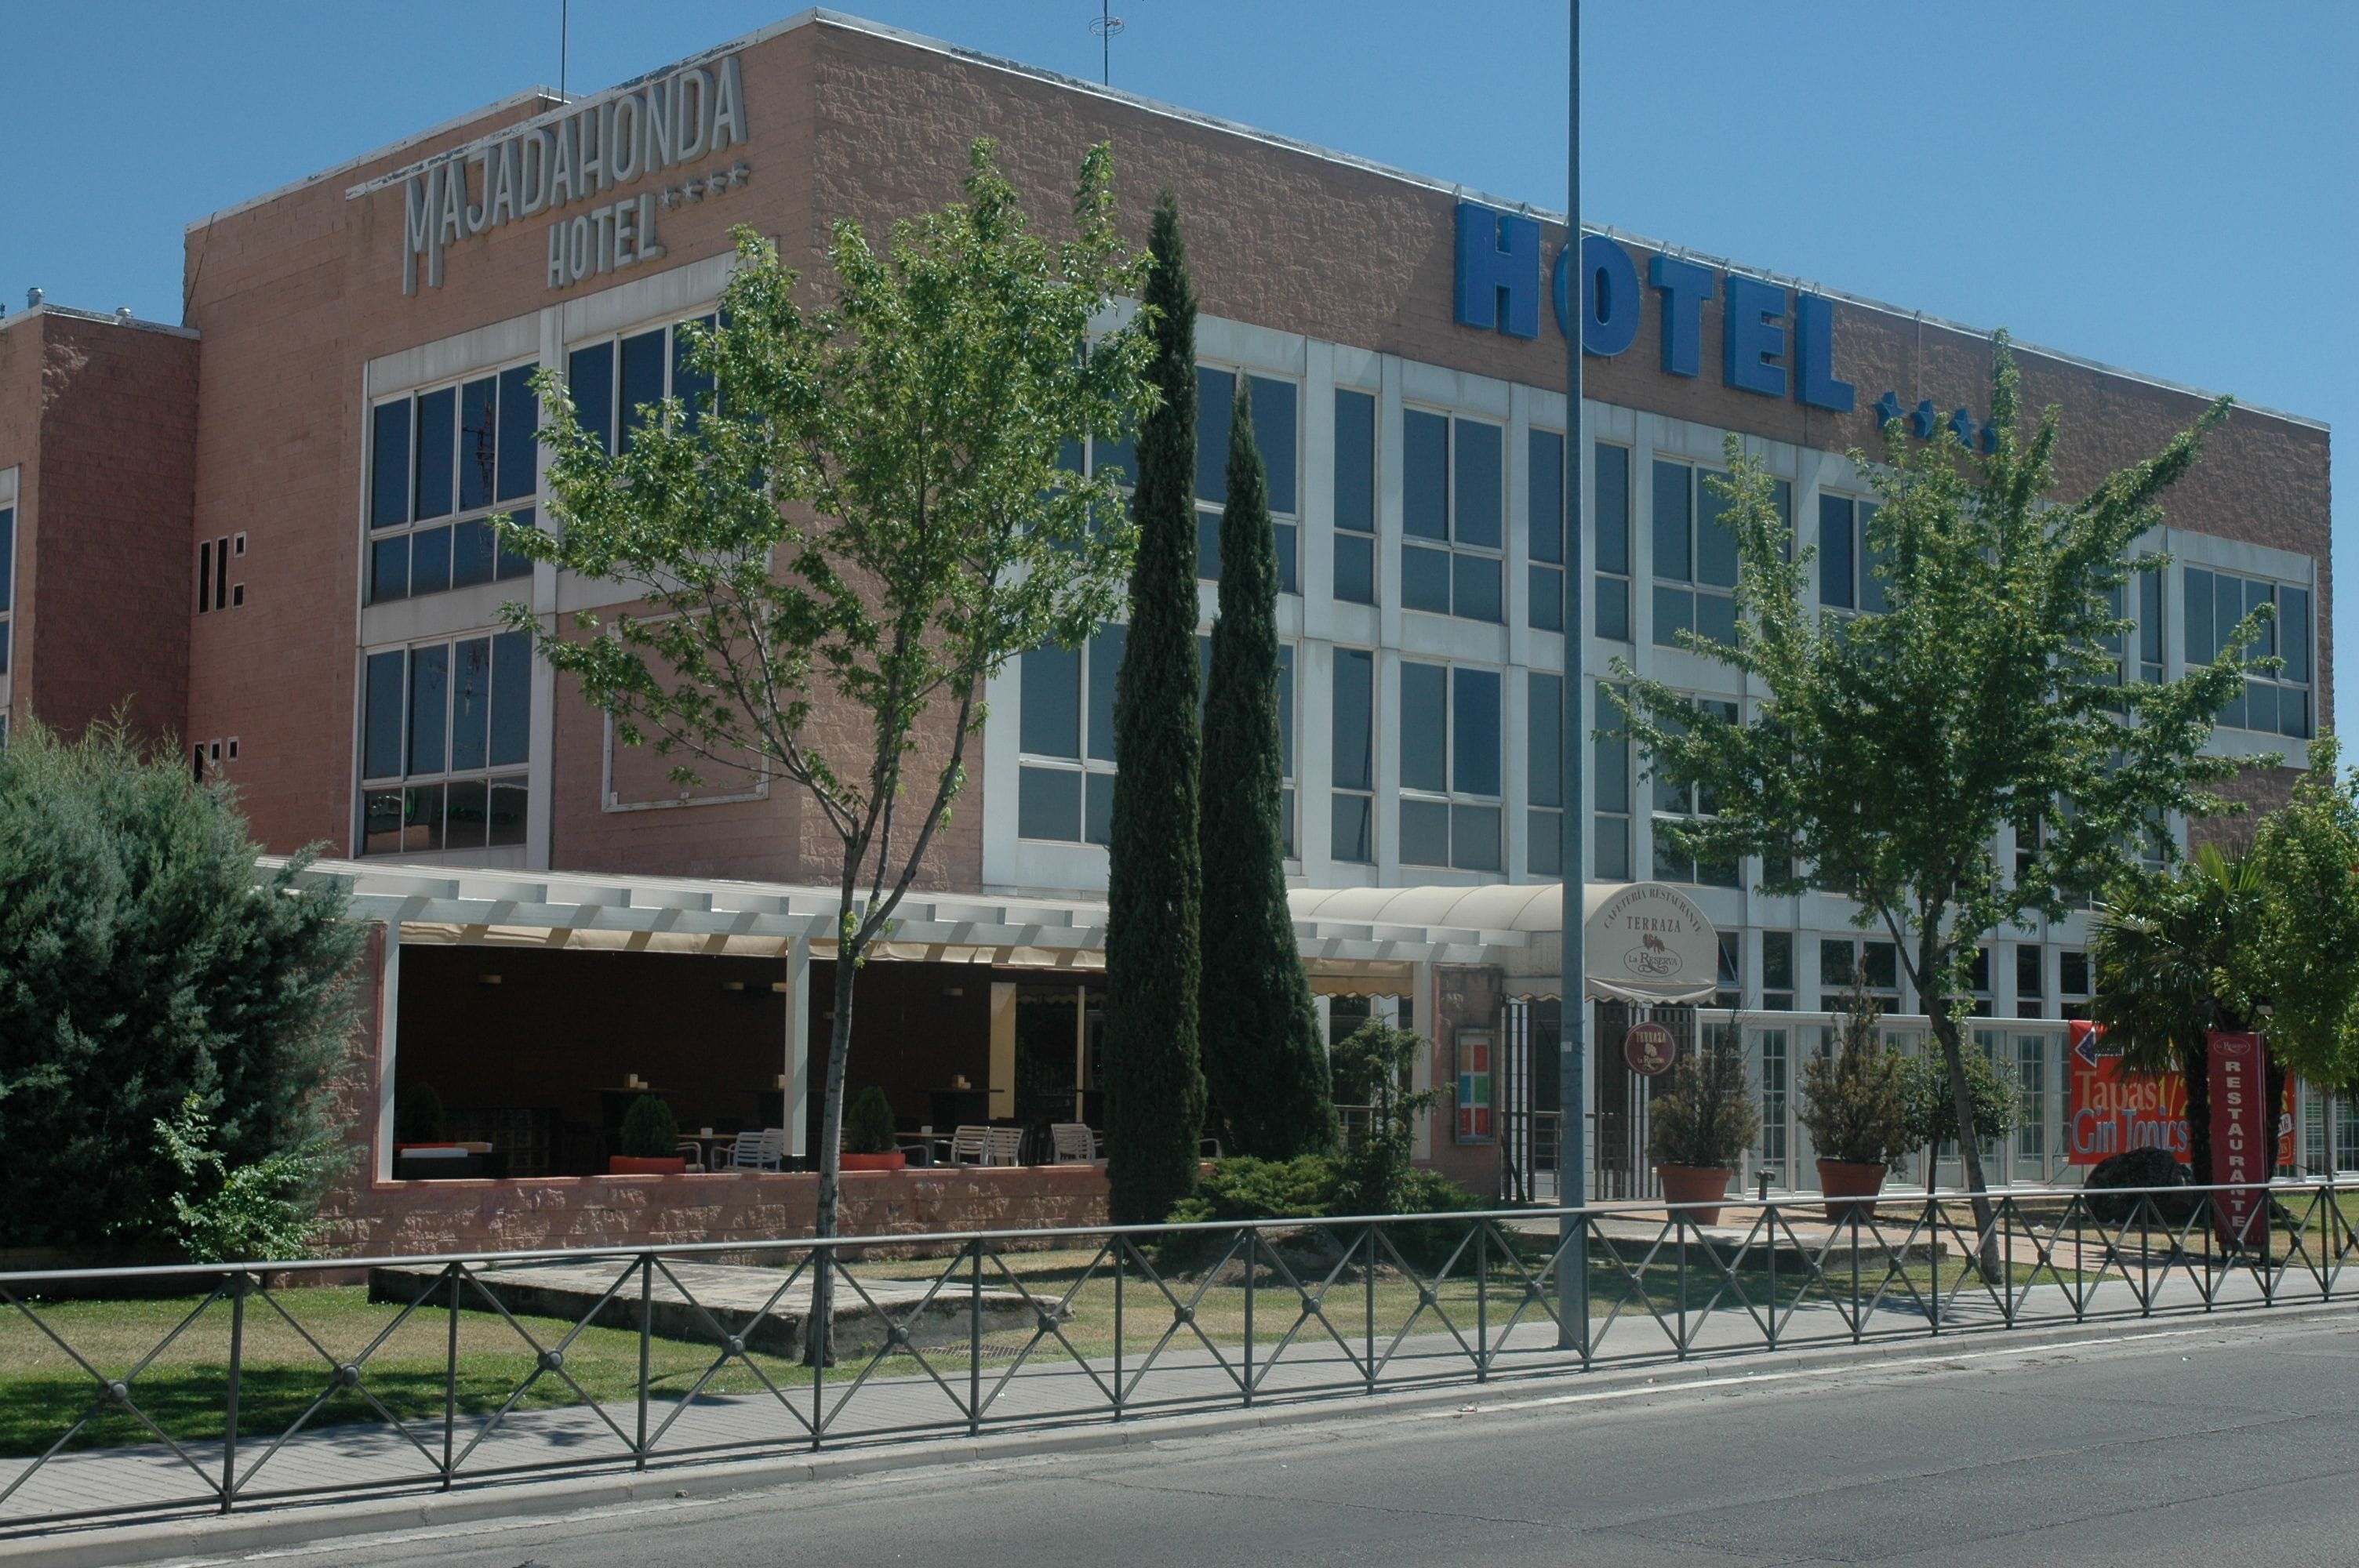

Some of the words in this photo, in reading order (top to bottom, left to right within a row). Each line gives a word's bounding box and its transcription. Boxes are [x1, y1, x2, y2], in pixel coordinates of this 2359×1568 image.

[402, 56, 749, 296] MAJADAHONDA
[547, 193, 667, 289] HOTEL
[1455, 202, 1856, 413] HOTEL
[1627, 916, 1681, 933] TERRAZA
[2073, 1105, 2117, 1154] Gin
[2121, 1105, 2189, 1152] Tonics
[2075, 1071, 2157, 1123] Tapas
[2225, 1061, 2246, 1228] RESTAURANTE
